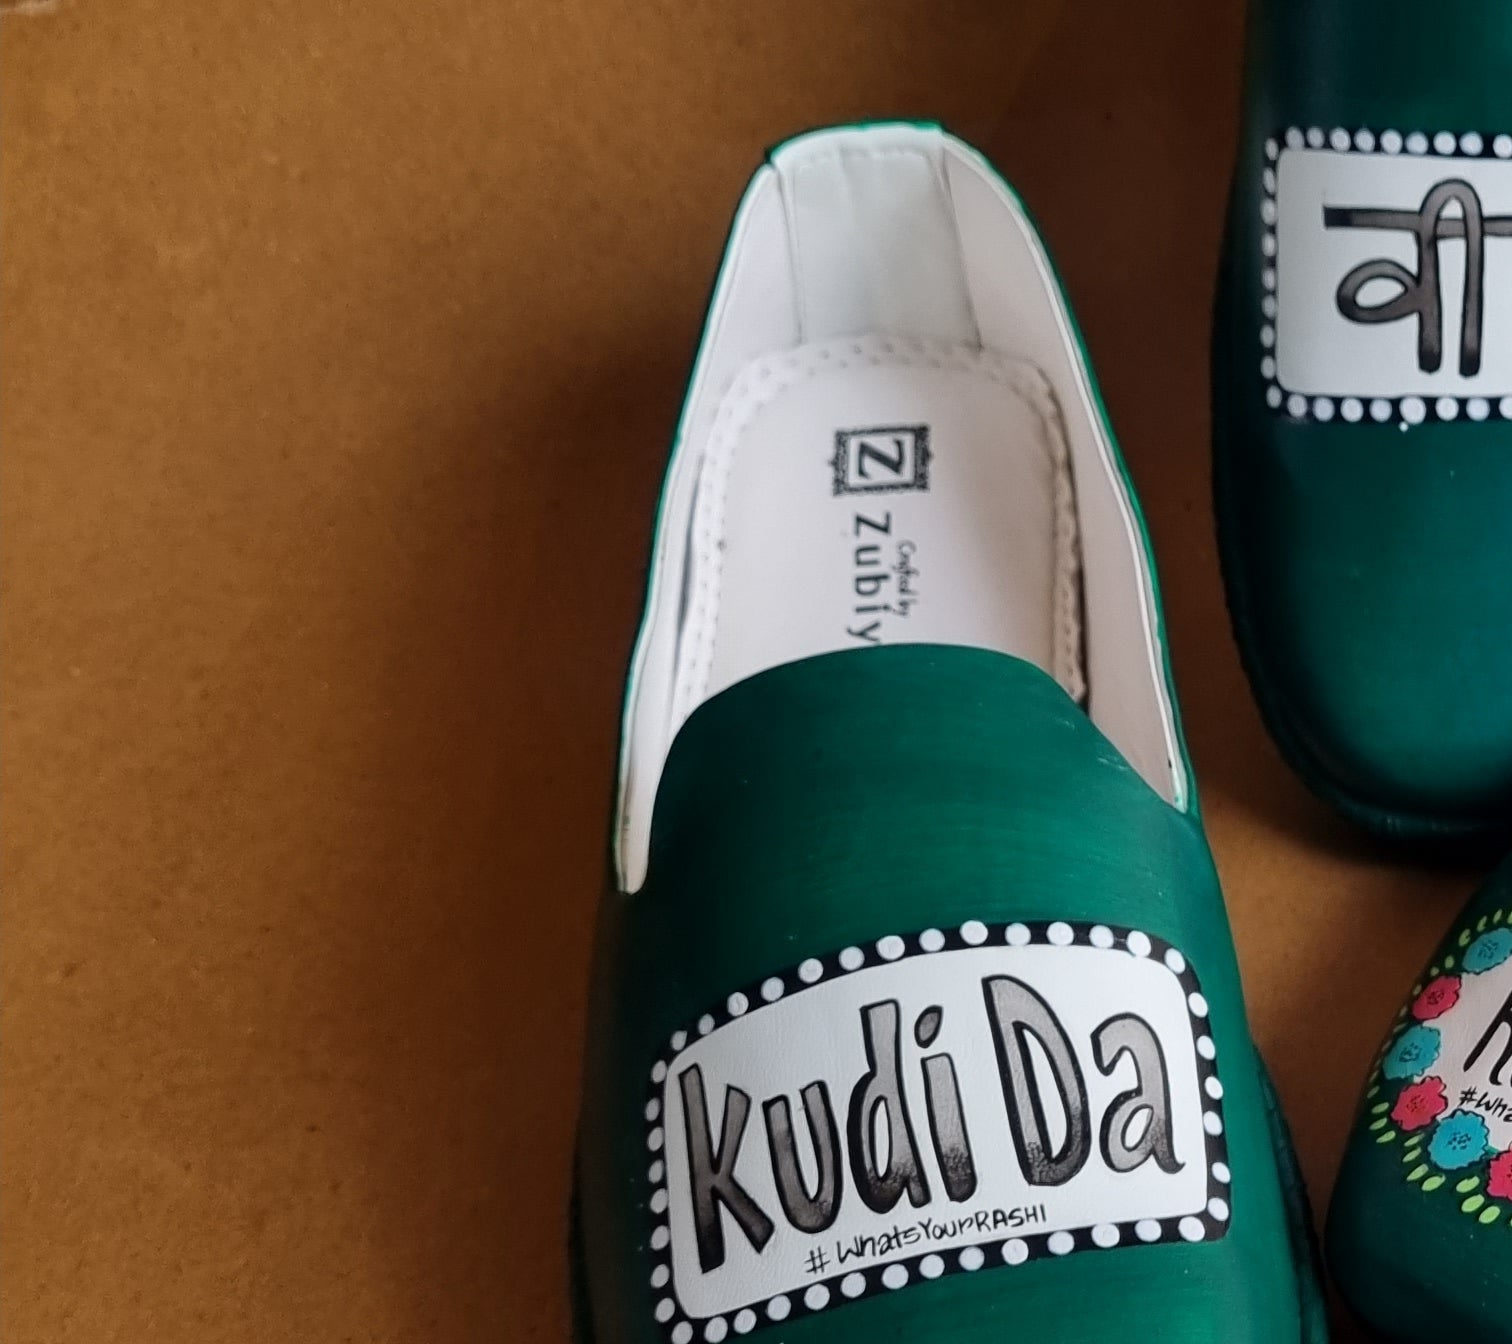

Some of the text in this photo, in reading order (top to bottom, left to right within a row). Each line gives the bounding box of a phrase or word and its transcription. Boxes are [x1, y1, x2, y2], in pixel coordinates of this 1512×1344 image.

[858, 439, 906, 479] Z
[847, 511, 891, 644] Zubiy
[982, 973, 1186, 1186] Da
